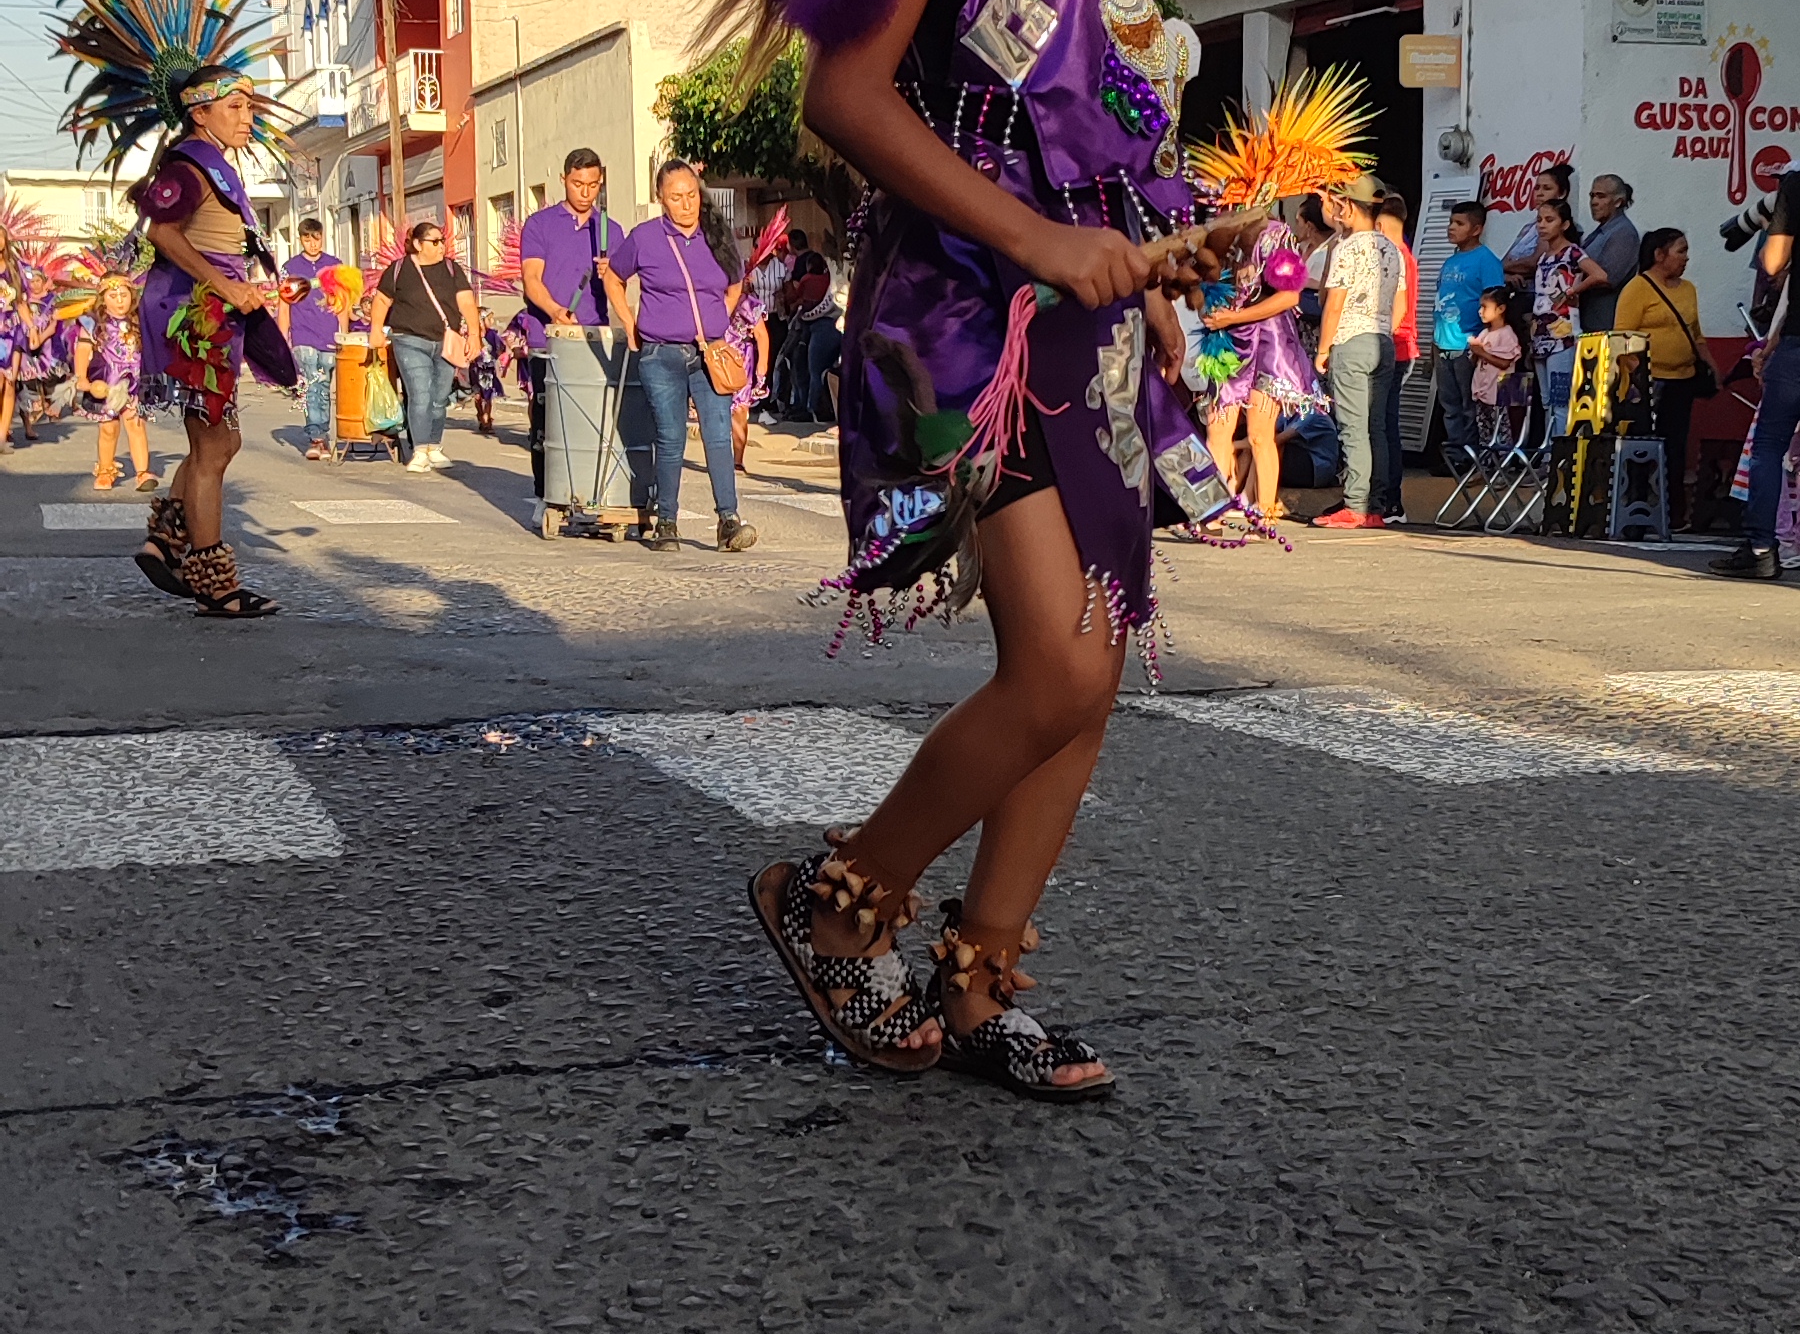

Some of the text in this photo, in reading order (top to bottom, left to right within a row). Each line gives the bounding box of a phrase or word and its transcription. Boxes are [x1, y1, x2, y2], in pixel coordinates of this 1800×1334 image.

[1679, 77, 1708, 99] DA
[1634, 101, 1731, 131] GUSTO
[1672, 128, 1732, 161] AQUÍ
